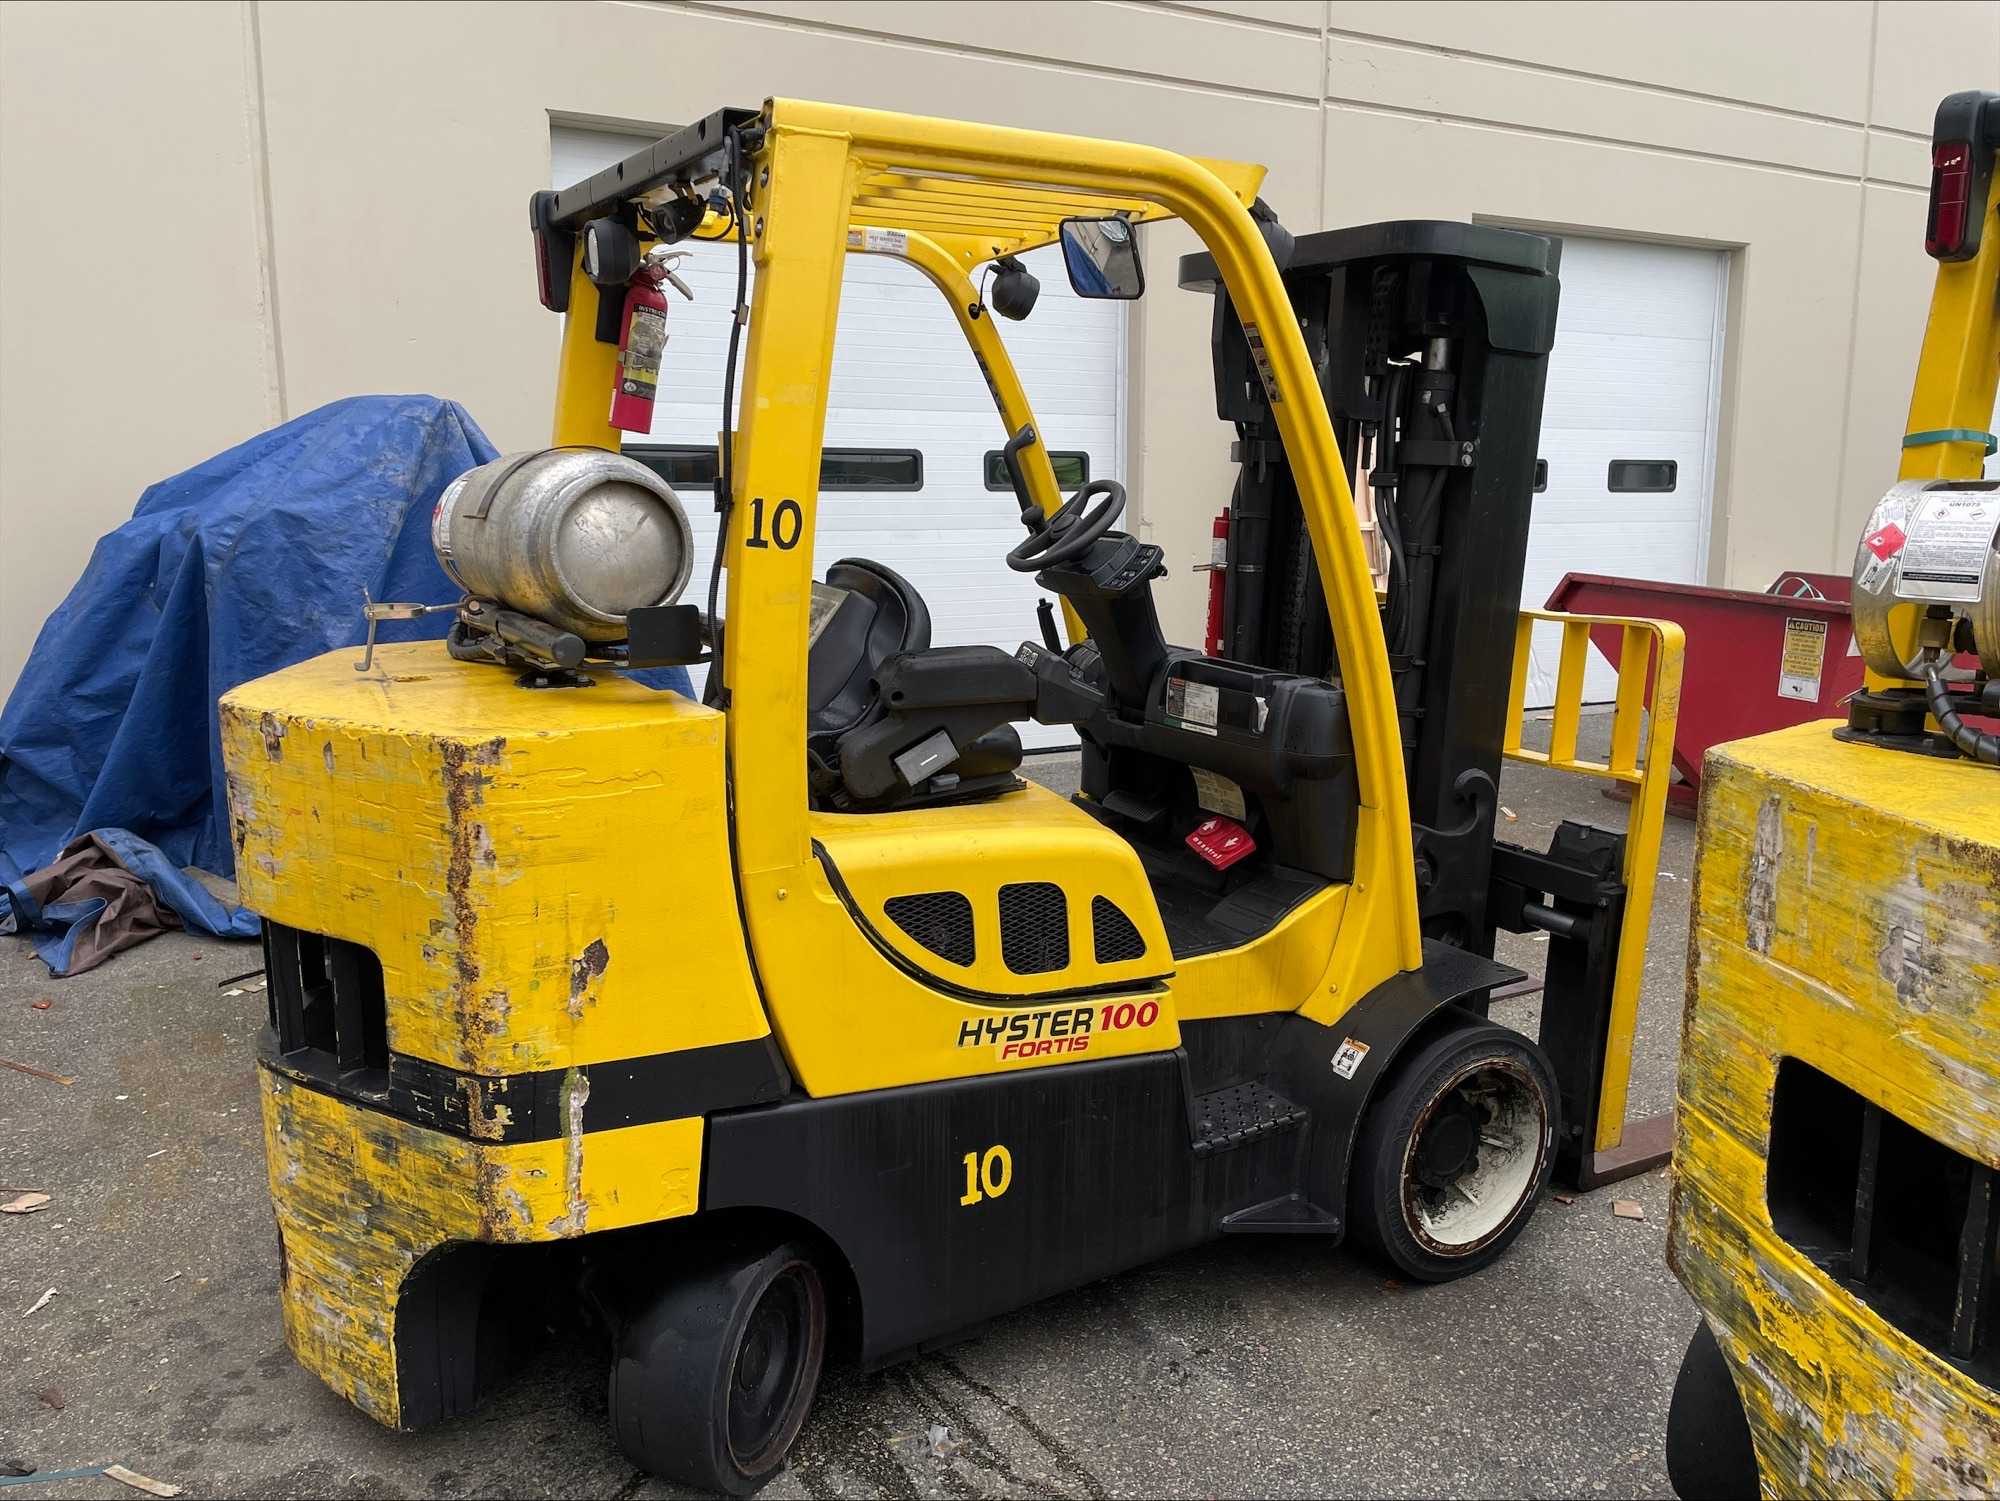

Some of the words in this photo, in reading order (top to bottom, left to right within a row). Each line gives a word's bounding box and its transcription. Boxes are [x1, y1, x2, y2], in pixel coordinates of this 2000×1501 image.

[746, 498, 802, 549] 10
[1796, 622, 1824, 632] CAUTION
[958, 1007, 1094, 1047] HYSTER
[1101, 1001, 1159, 1031] 100
[1002, 1035, 1090, 1060] FORTIS
[960, 1145, 1012, 1206] 10
